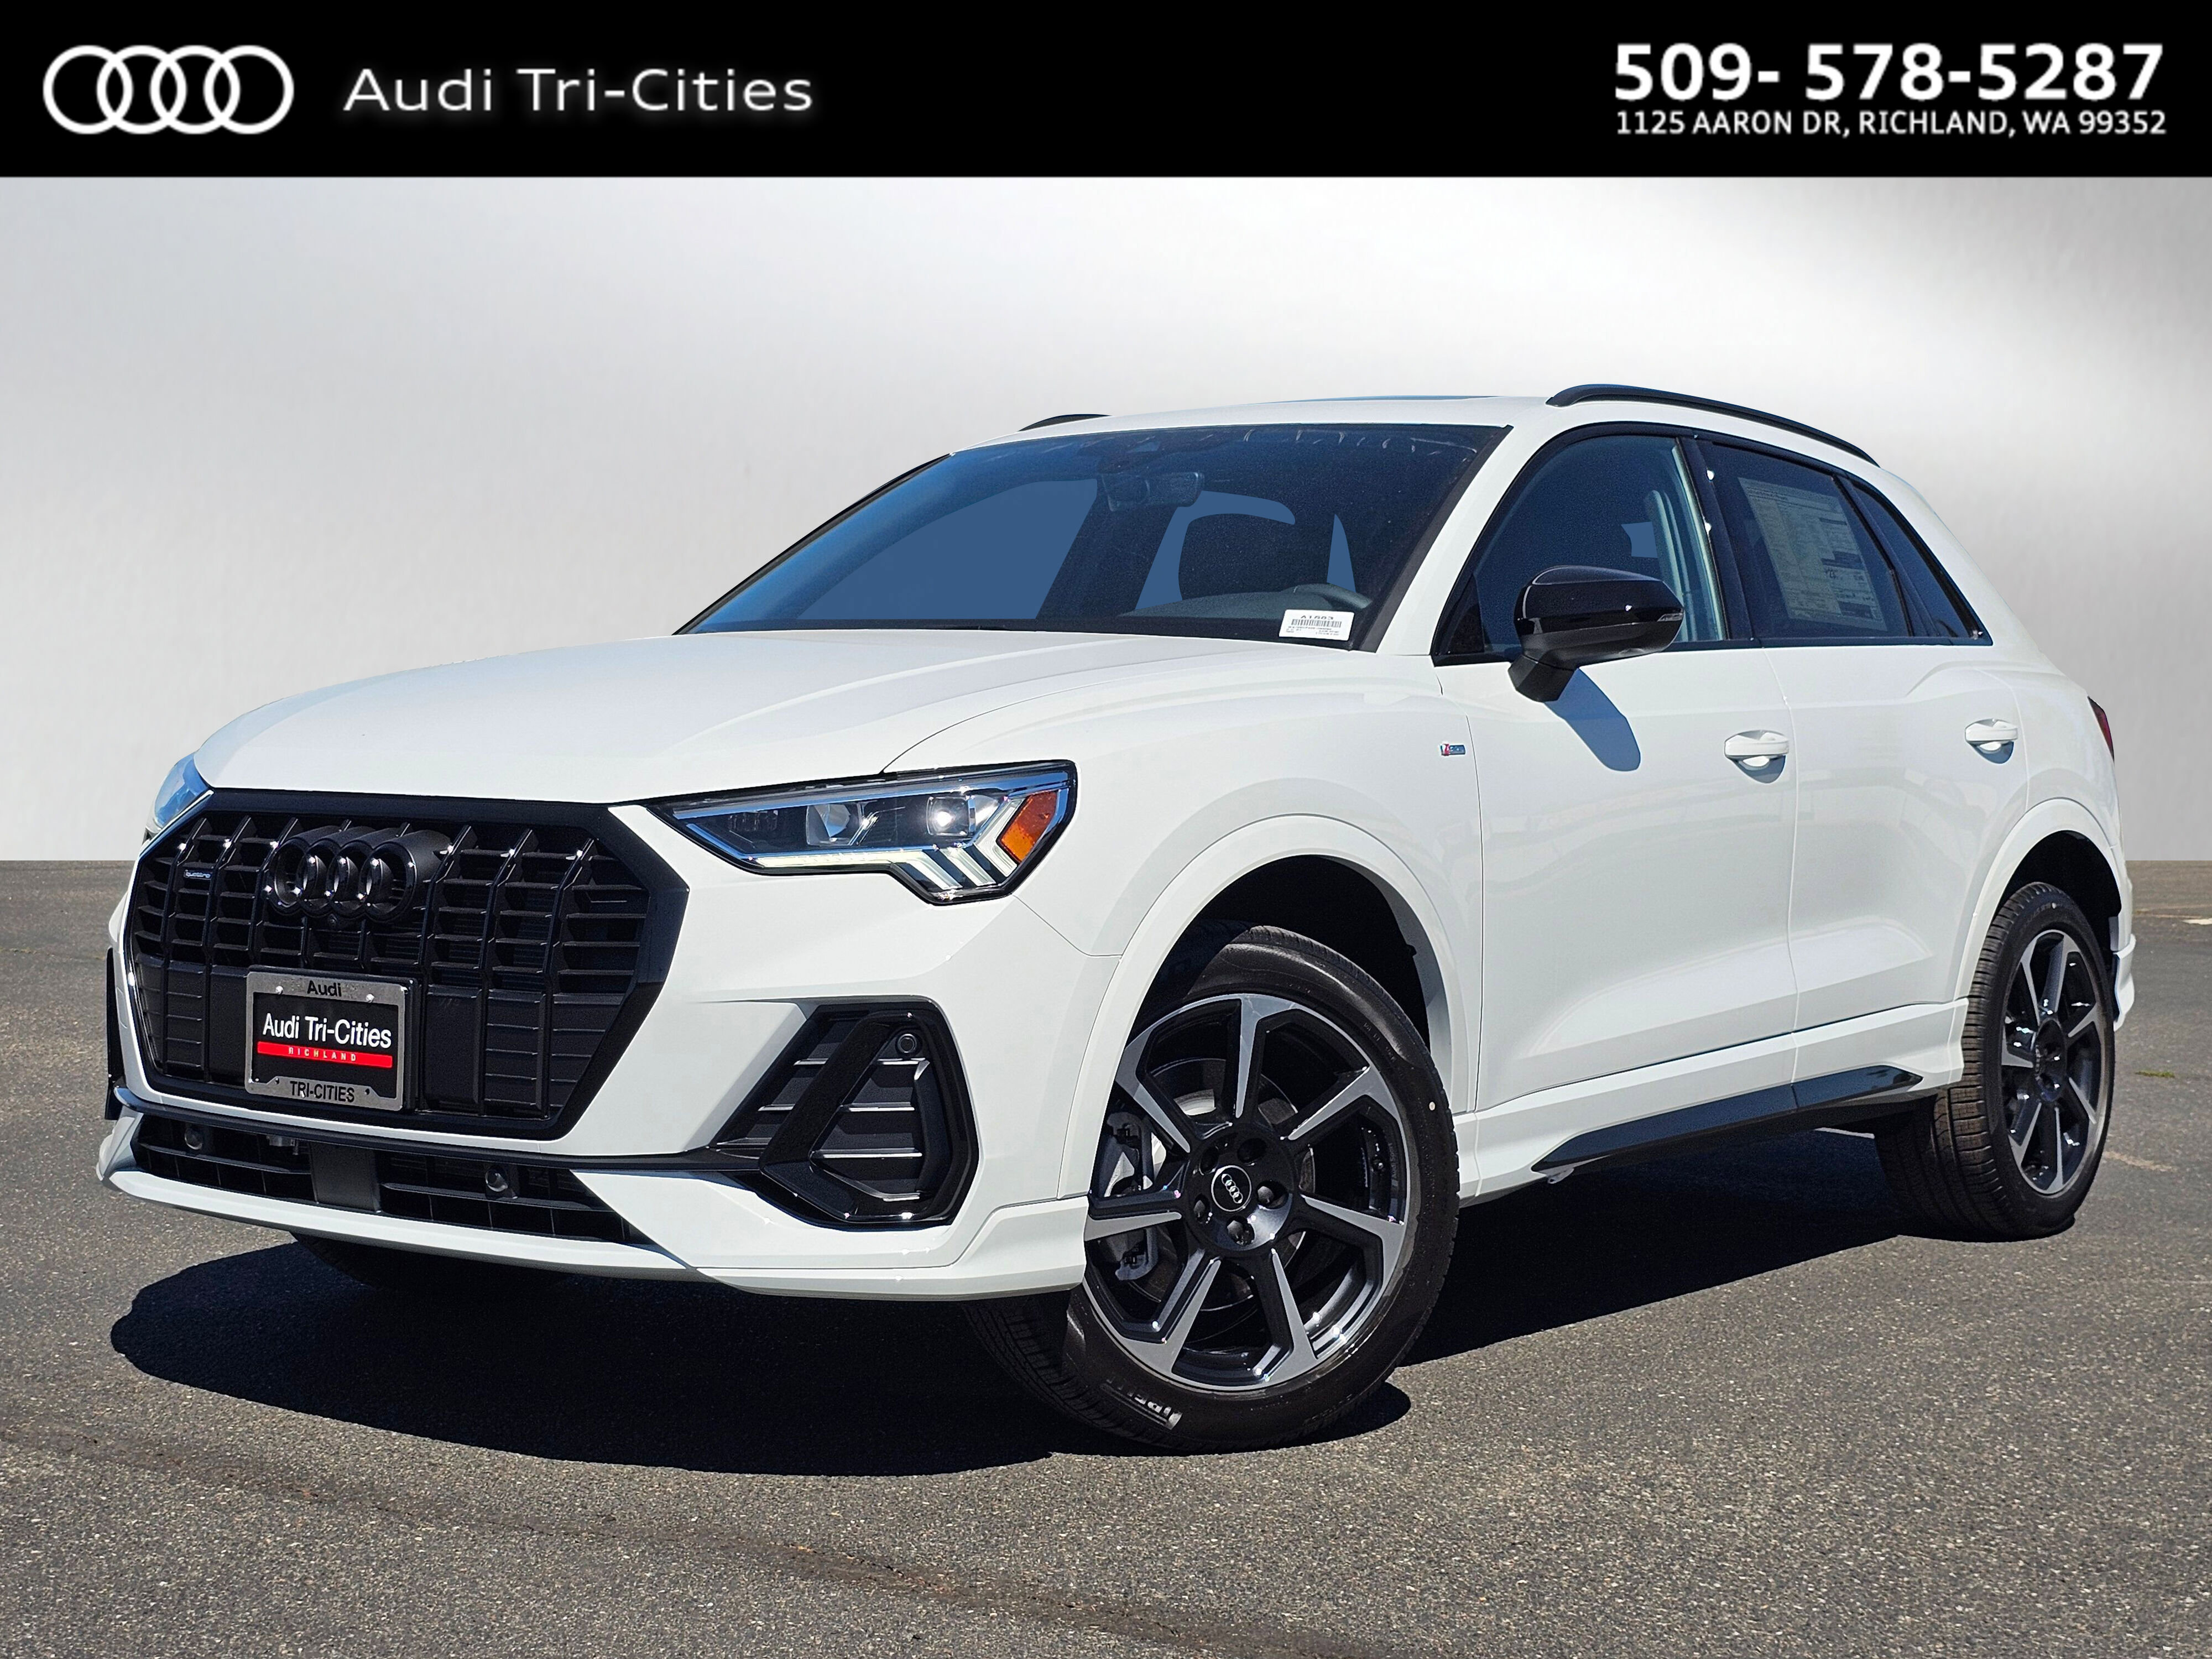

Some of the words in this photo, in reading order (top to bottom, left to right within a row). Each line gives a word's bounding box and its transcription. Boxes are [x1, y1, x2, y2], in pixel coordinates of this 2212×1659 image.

[307, 980, 342, 997] Audi
[263, 1013, 300, 1039] Audi
[305, 1016, 392, 1048] Tri-Cities
[288, 1046, 357, 1062] RICHLAND
[290, 1081, 354, 1103] TRI-CITIES
